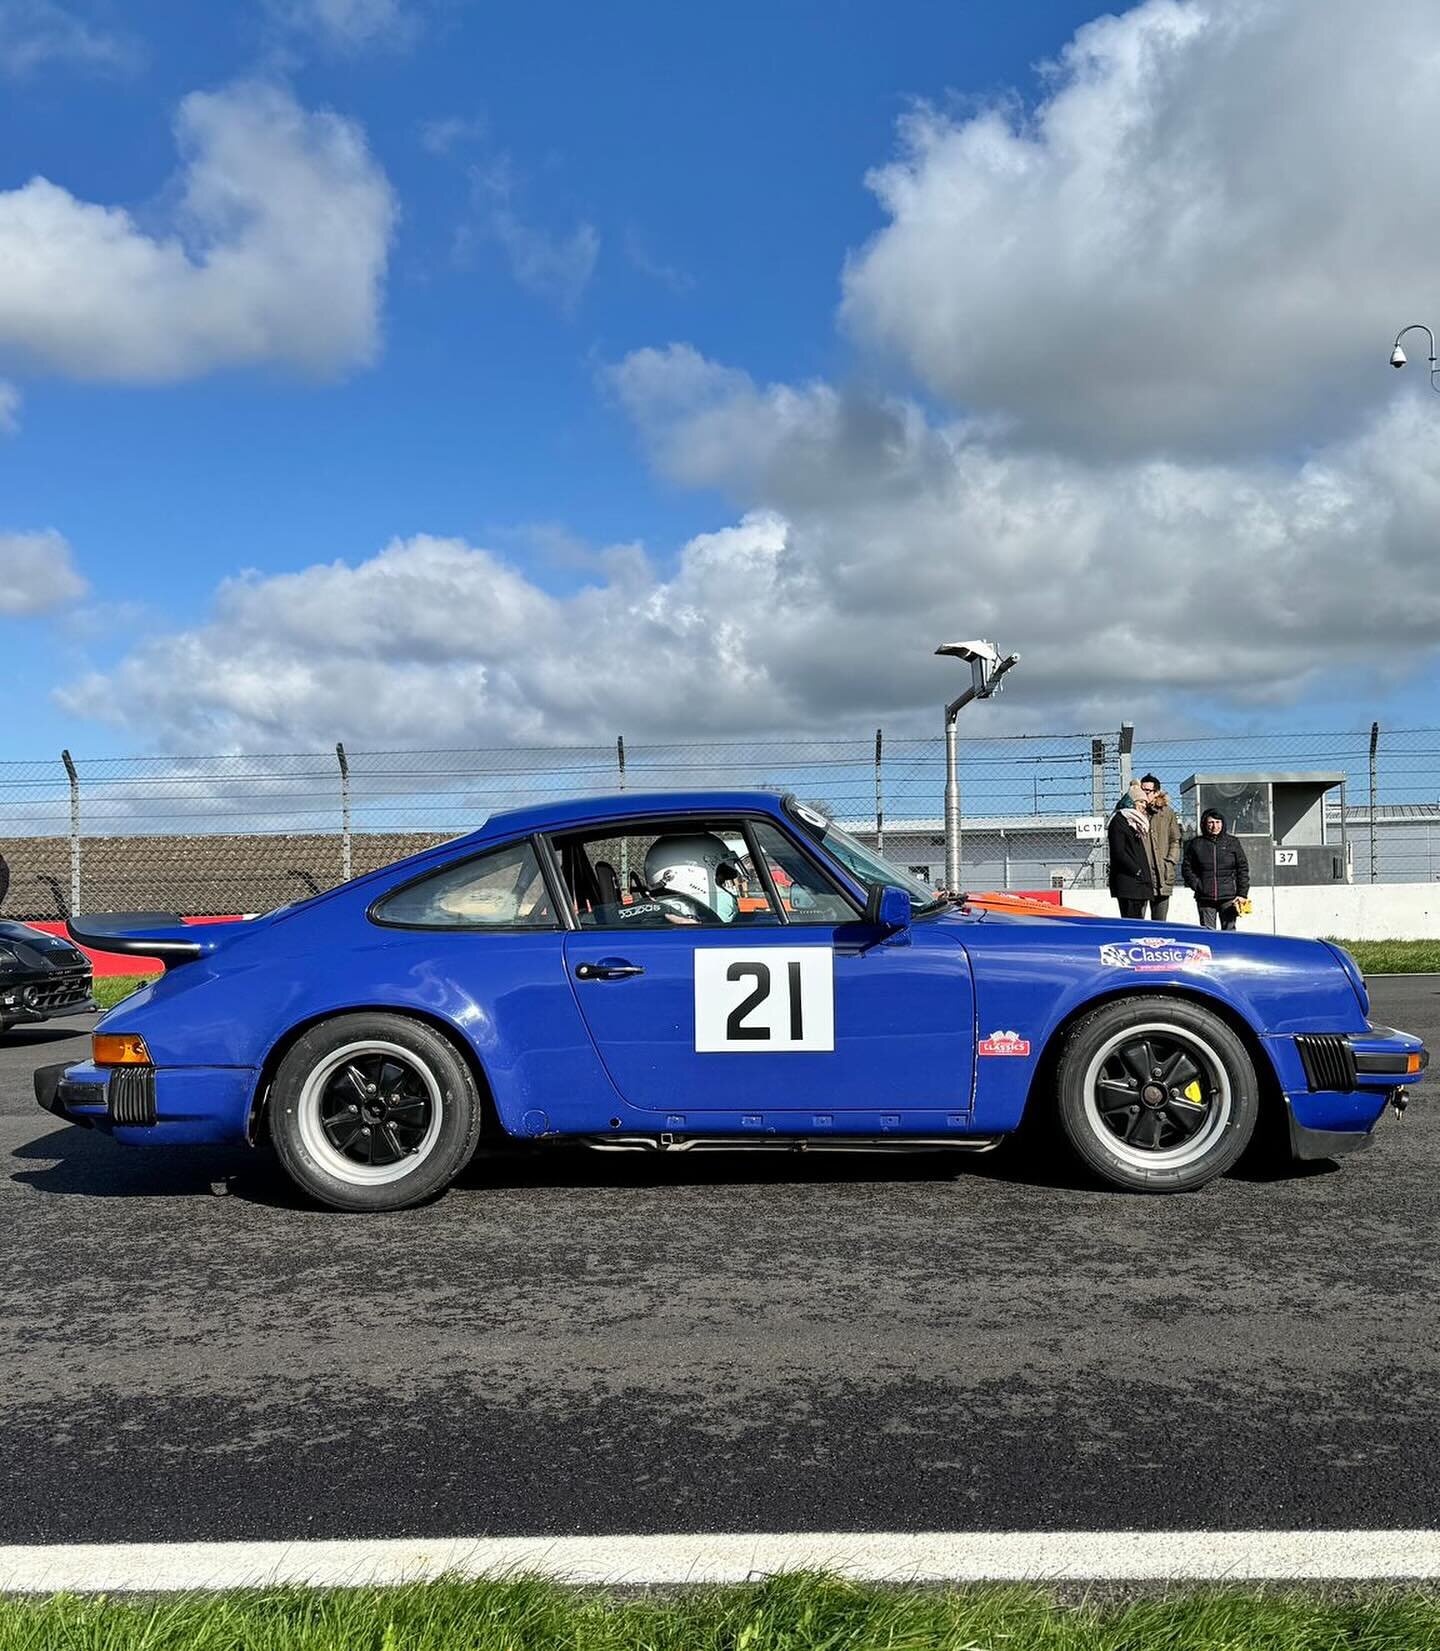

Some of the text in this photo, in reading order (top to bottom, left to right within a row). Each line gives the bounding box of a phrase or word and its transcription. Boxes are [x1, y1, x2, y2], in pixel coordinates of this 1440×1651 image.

[1093, 824, 1102, 832] 17
[1279, 853, 1293, 862] 37
[1128, 946, 1183, 962] Classic
[726, 961, 804, 1041] 21
